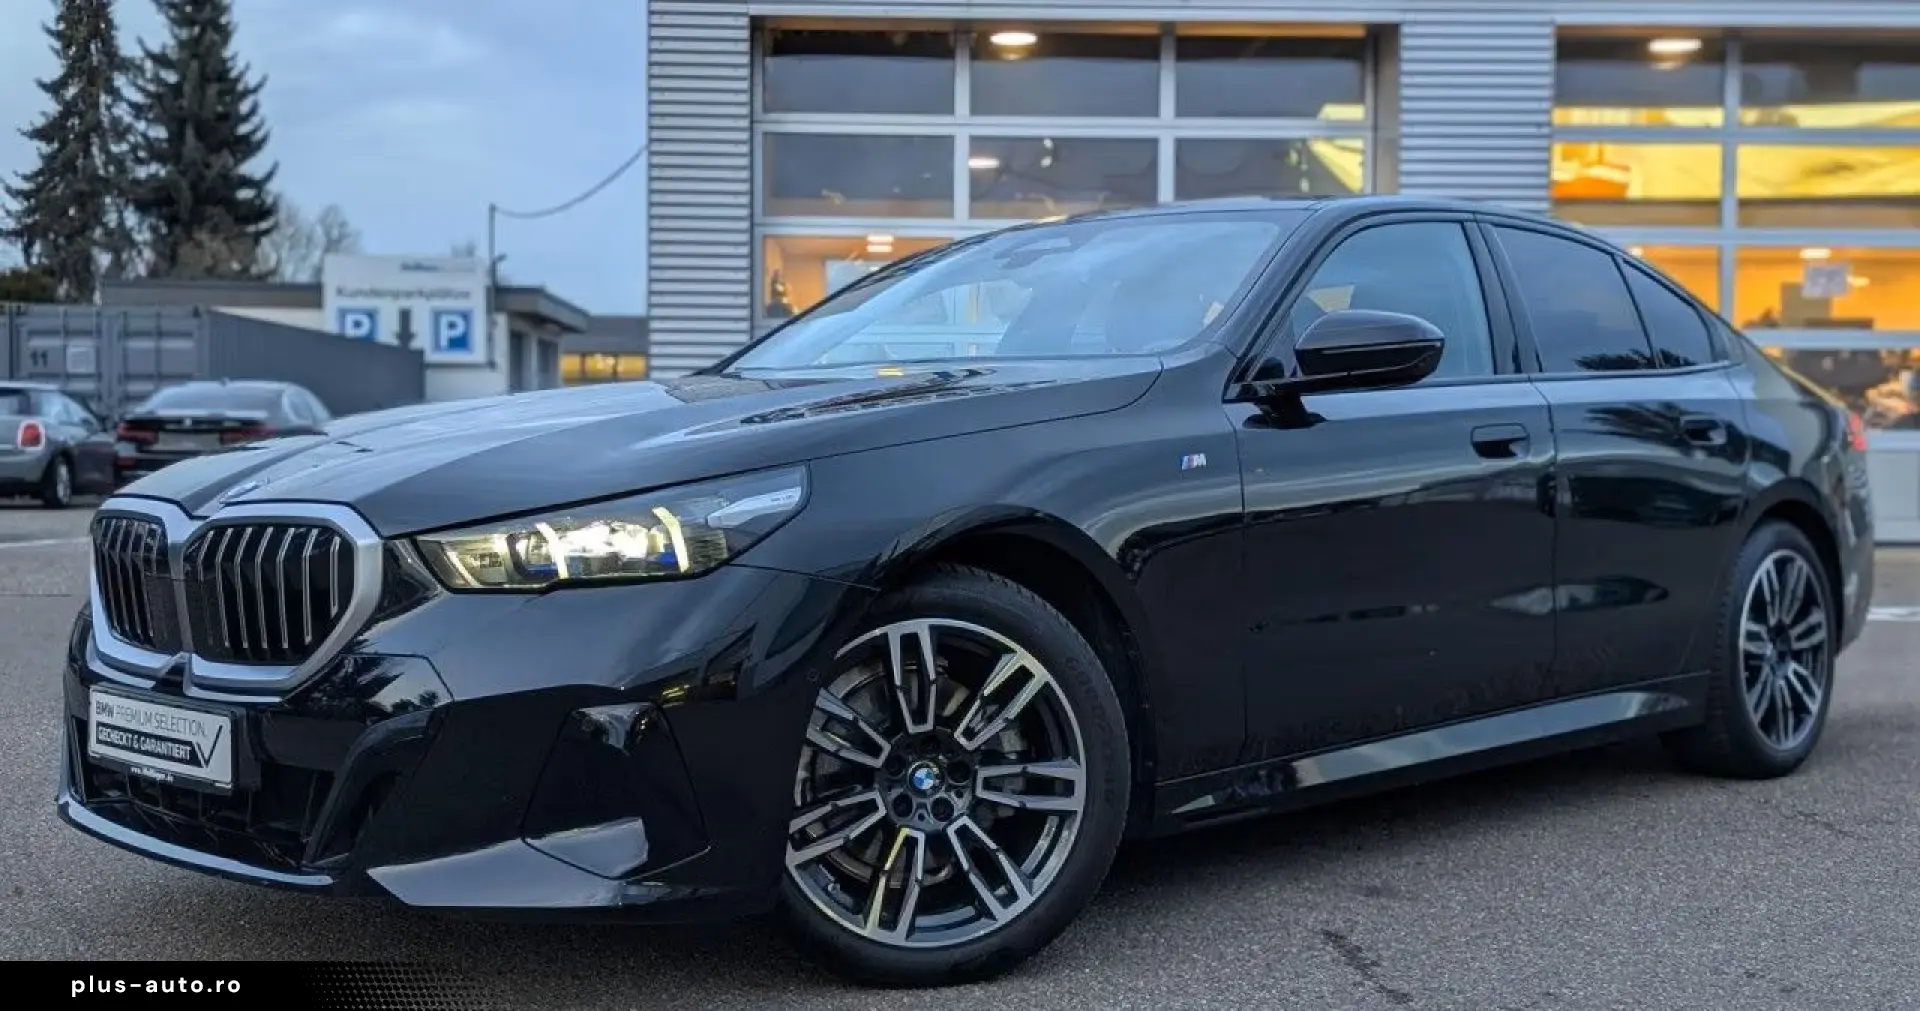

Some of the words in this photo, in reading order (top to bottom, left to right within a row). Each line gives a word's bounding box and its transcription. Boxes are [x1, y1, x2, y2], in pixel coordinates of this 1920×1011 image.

[439, 313, 466, 349] P
[30, 350, 49, 368] 11
[95, 700, 114, 719] BMW
[115, 704, 153, 728] PREMIUM
[98, 726, 132, 747] GECHECKT
[133, 733, 139, 748] &
[140, 735, 192, 760] GARANTIERT
